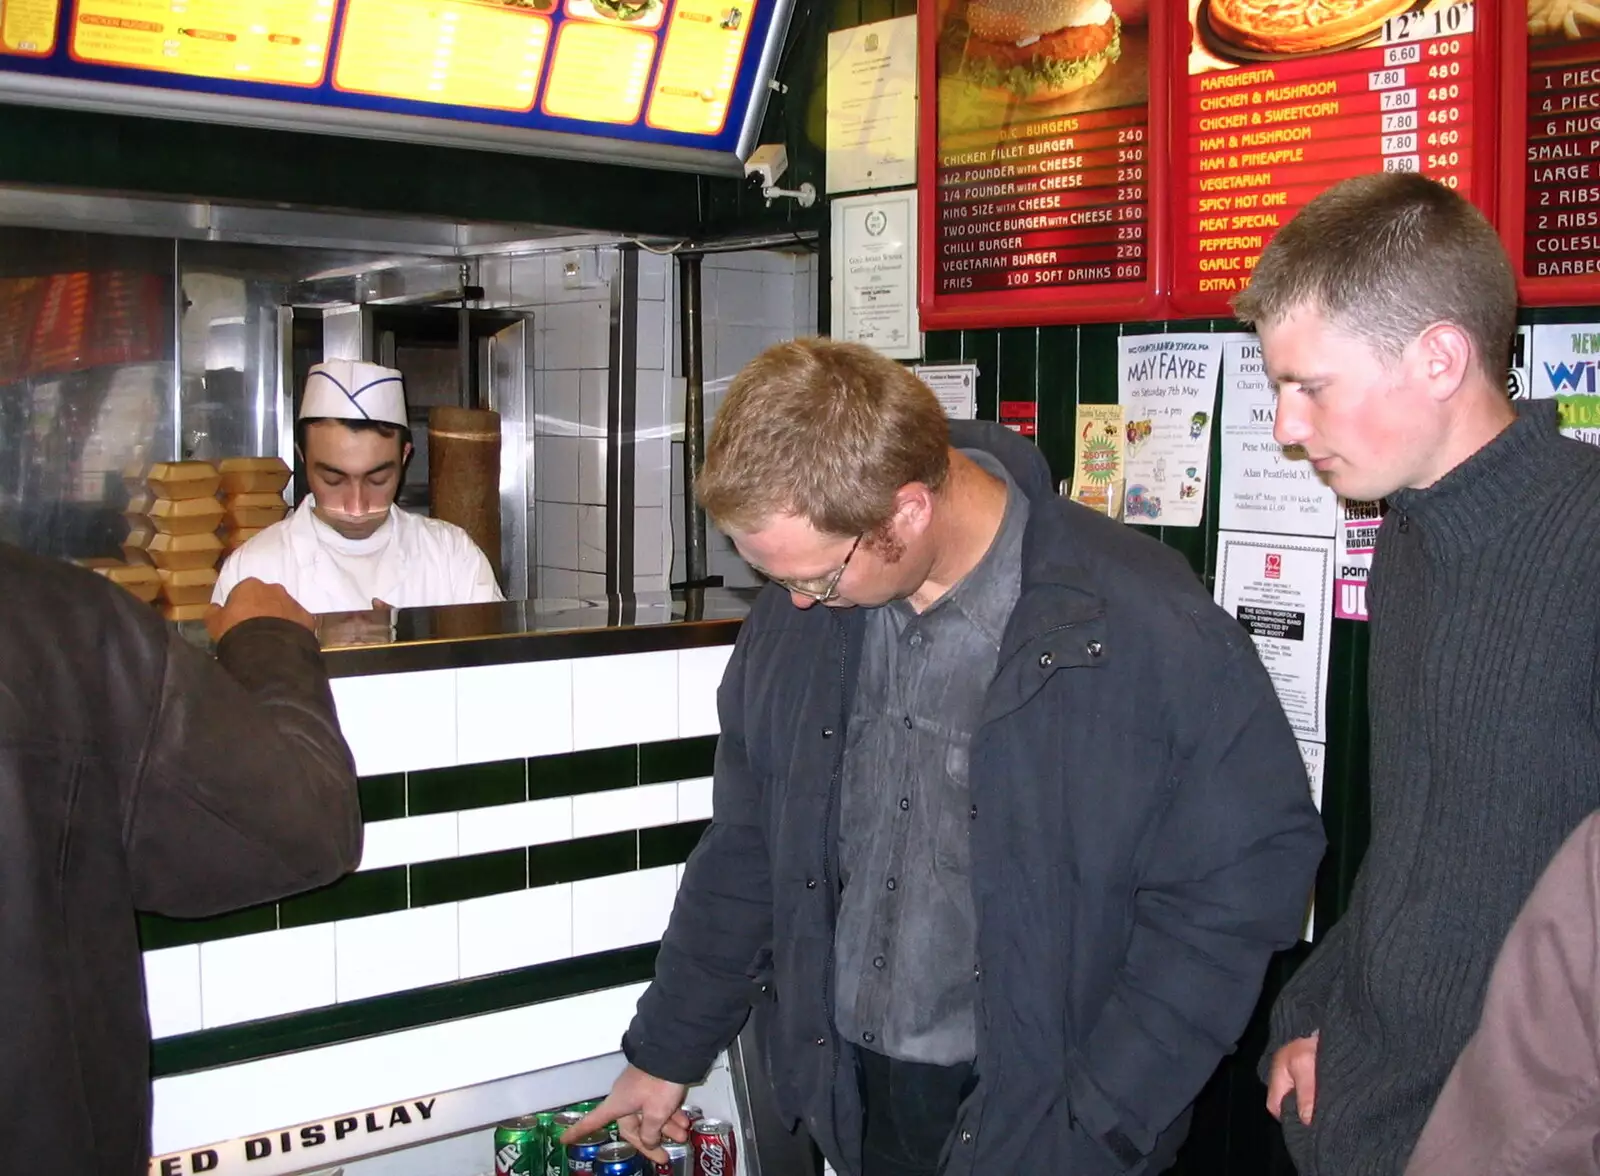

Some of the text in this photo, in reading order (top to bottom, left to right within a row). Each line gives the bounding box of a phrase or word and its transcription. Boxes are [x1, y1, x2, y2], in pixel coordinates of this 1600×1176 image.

[1201, 40, 1460, 91] MARGHERITA 6.60 400
[1200, 62, 1460, 111] CHICKEN & MUSHROOM 7.80 480
[1545, 76, 1552, 89] 1
[1200, 85, 1459, 131] CHICKEN & SWEETCORN 7.80 480
[1543, 100, 1552, 112] 4
[1026, 119, 1079, 137] BURGERS
[1200, 108, 1459, 151] HAM & MUSHROOM 7.80 460
[1547, 122, 1556, 135] 6
[944, 130, 1143, 167] CHICKEN FILLET BURGER 240
[1200, 131, 1459, 171] HAM & PINEAPPLE 7.80 460
[1528, 142, 1581, 160] SMALL
[944, 149, 1143, 185] 1/2 POUNDER WITH CHEESE 340
[1200, 152, 1459, 191] VEGETARIAN 8.60 540
[1534, 165, 1589, 182] LARGE
[944, 168, 1143, 203] 1/4 POUNDER WITH CHEESE 230
[943, 188, 1143, 220] KING SIZE WITH CHEESE 230
[1199, 197, 1232, 212] SPICY
[1235, 195, 1258, 208] HOT
[1262, 192, 1287, 206] ONE
[1540, 192, 1549, 205] 2
[944, 207, 1142, 237] TWO OUNCE BURGER WITH CHEESE 160
[1200, 214, 1279, 232] MEAT SPECIAL
[1538, 212, 1598, 229] 2 RIBS
[944, 227, 1142, 255] CHILLI BURGER 230
[1200, 236, 1262, 251] PEPPERONI
[942, 246, 1142, 272] VEGETARIAN BURGER 220
[1199, 257, 1241, 271] GARLIC
[943, 265, 1141, 289] FRIES 100 SOFT DRINKS 060
[1200, 279, 1236, 291] EXTRA
[1127, 353, 1207, 381] MAY FAYRE
[1141, 386, 1166, 398] Saturday
[1167, 385, 1180, 396] 7th
[1182, 385, 1199, 397] May
[1236, 381, 1264, 392] Charity
[1251, 409, 1273, 423] MA
[1242, 442, 1258, 452] Pete
[1243, 468, 1261, 478] Alan
[245, 1098, 436, 1161] DISPLAY
